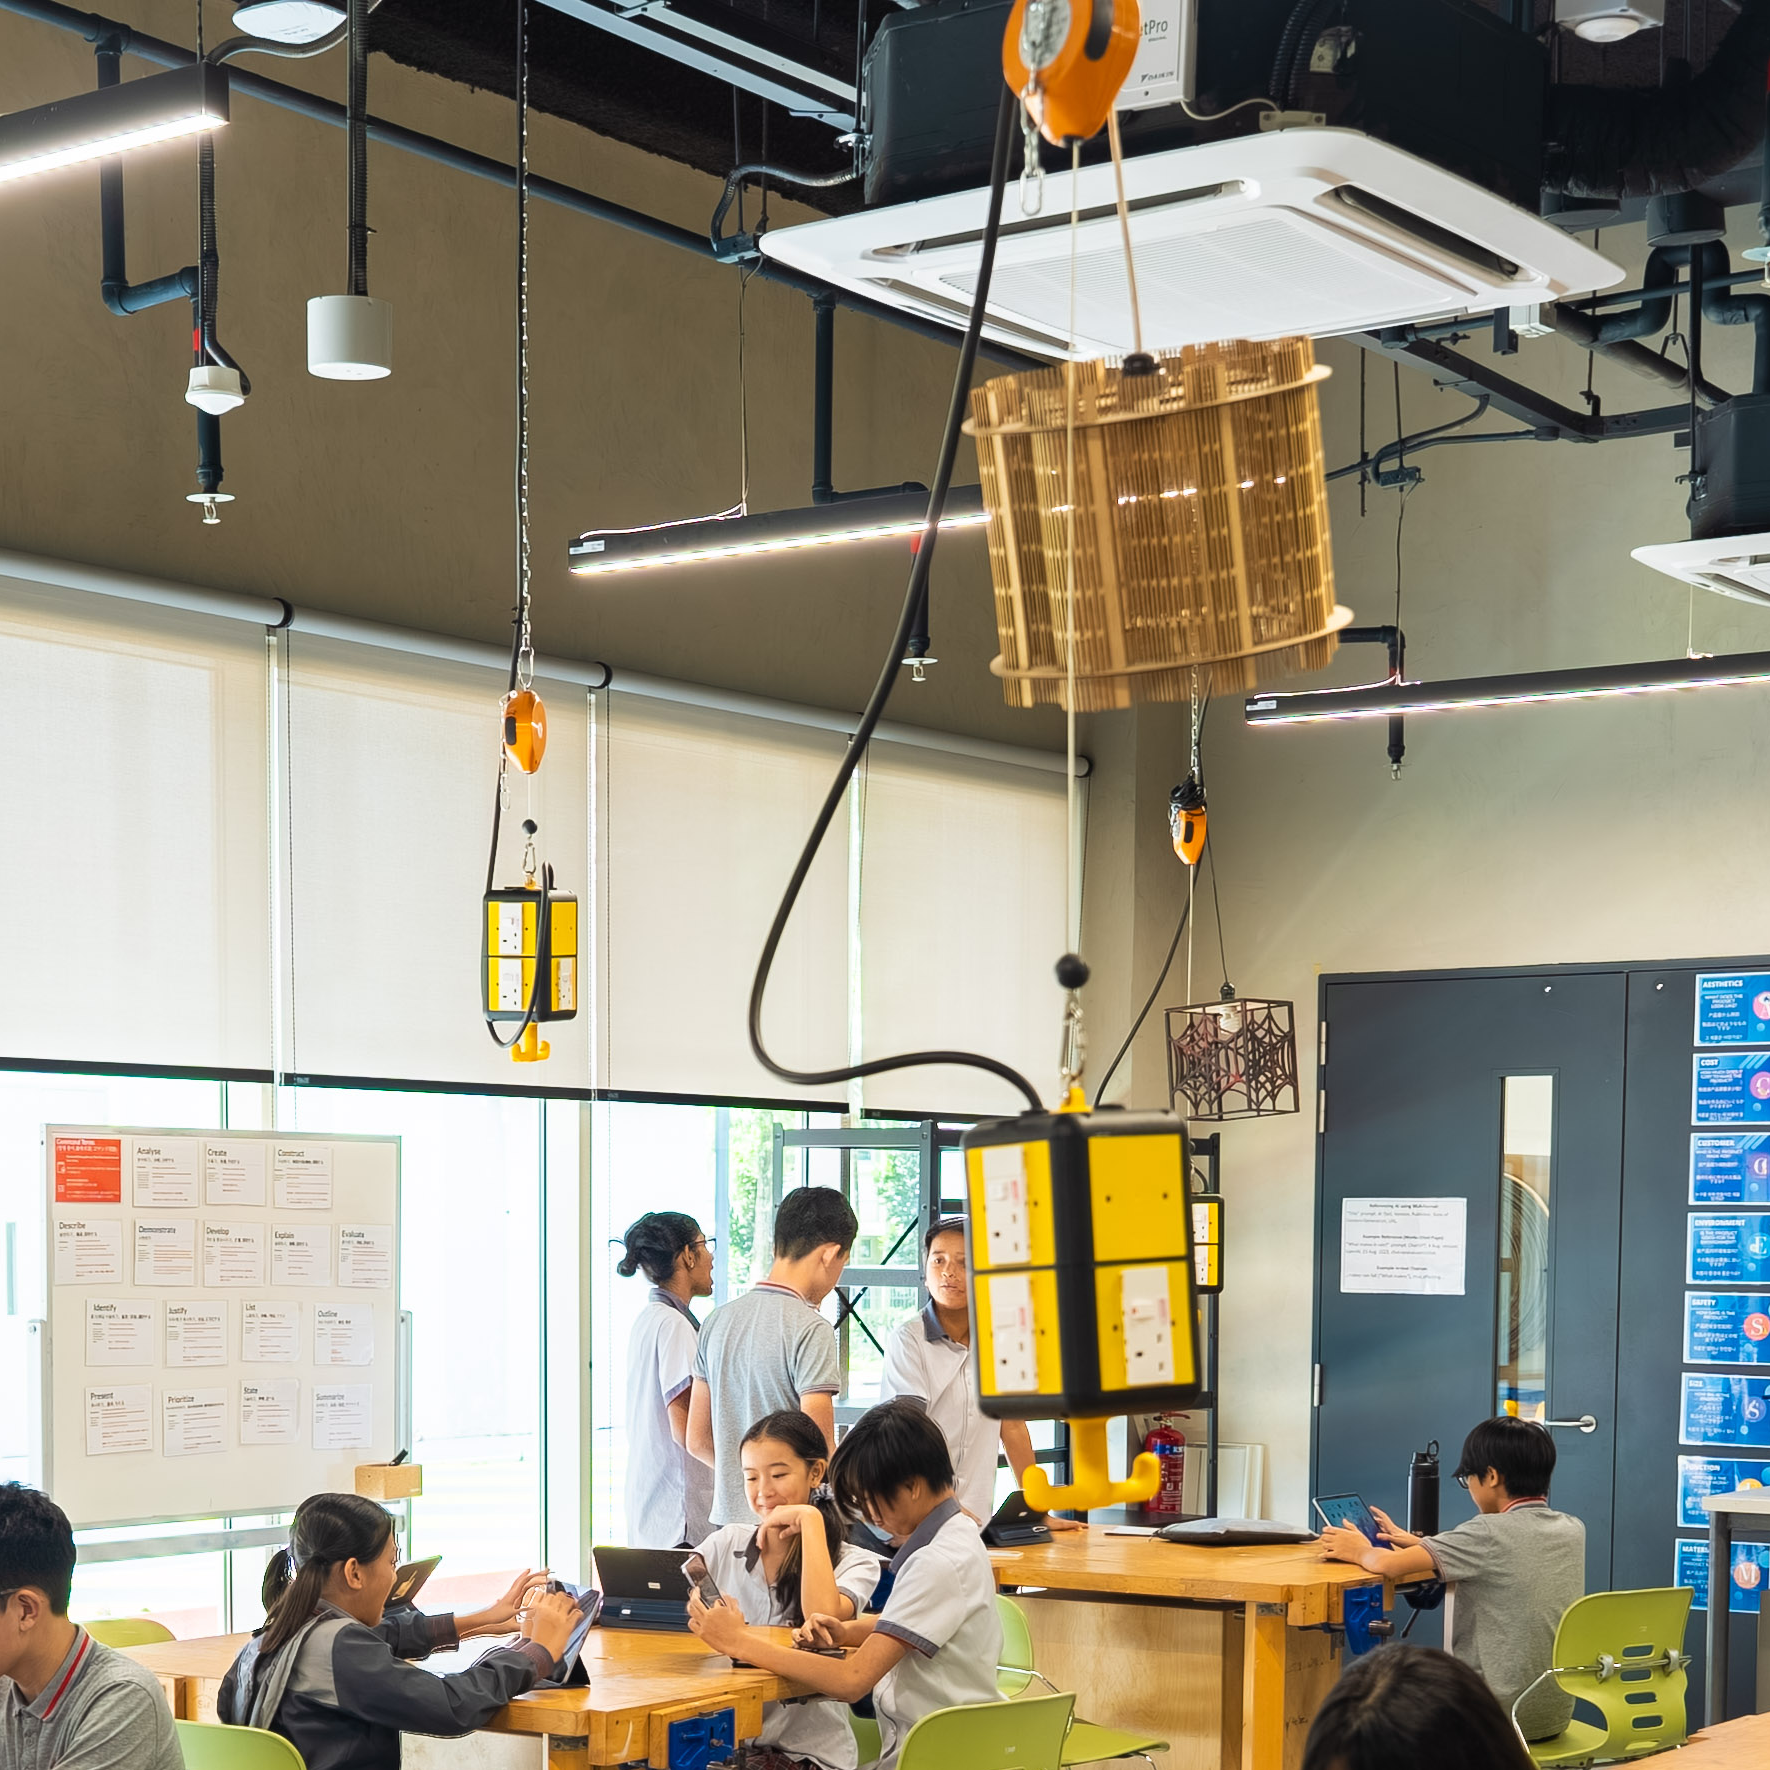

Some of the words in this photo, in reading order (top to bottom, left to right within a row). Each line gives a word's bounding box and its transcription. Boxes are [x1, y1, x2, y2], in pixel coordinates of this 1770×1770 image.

[1702, 980, 1744, 988] AESTHETICS
[137, 1147, 161, 1156] Analyse
[208, 1149, 227, 1157] Create
[278, 1149, 304, 1157] Construct
[59, 1222, 86, 1230] Describe
[206, 1227, 229, 1235] Develop
[342, 1230, 365, 1239] Evaluate
[274, 1231, 294, 1240] Explain
[93, 1304, 117, 1312] Identify
[168, 1307, 187, 1315] Justify
[318, 1310, 338, 1318] Outline
[1751, 1318, 1764, 1335] S
[90, 1392, 114, 1400] Present
[168, 1396, 195, 1404] Prioritize
[1739, 1564, 1757, 1584] M
